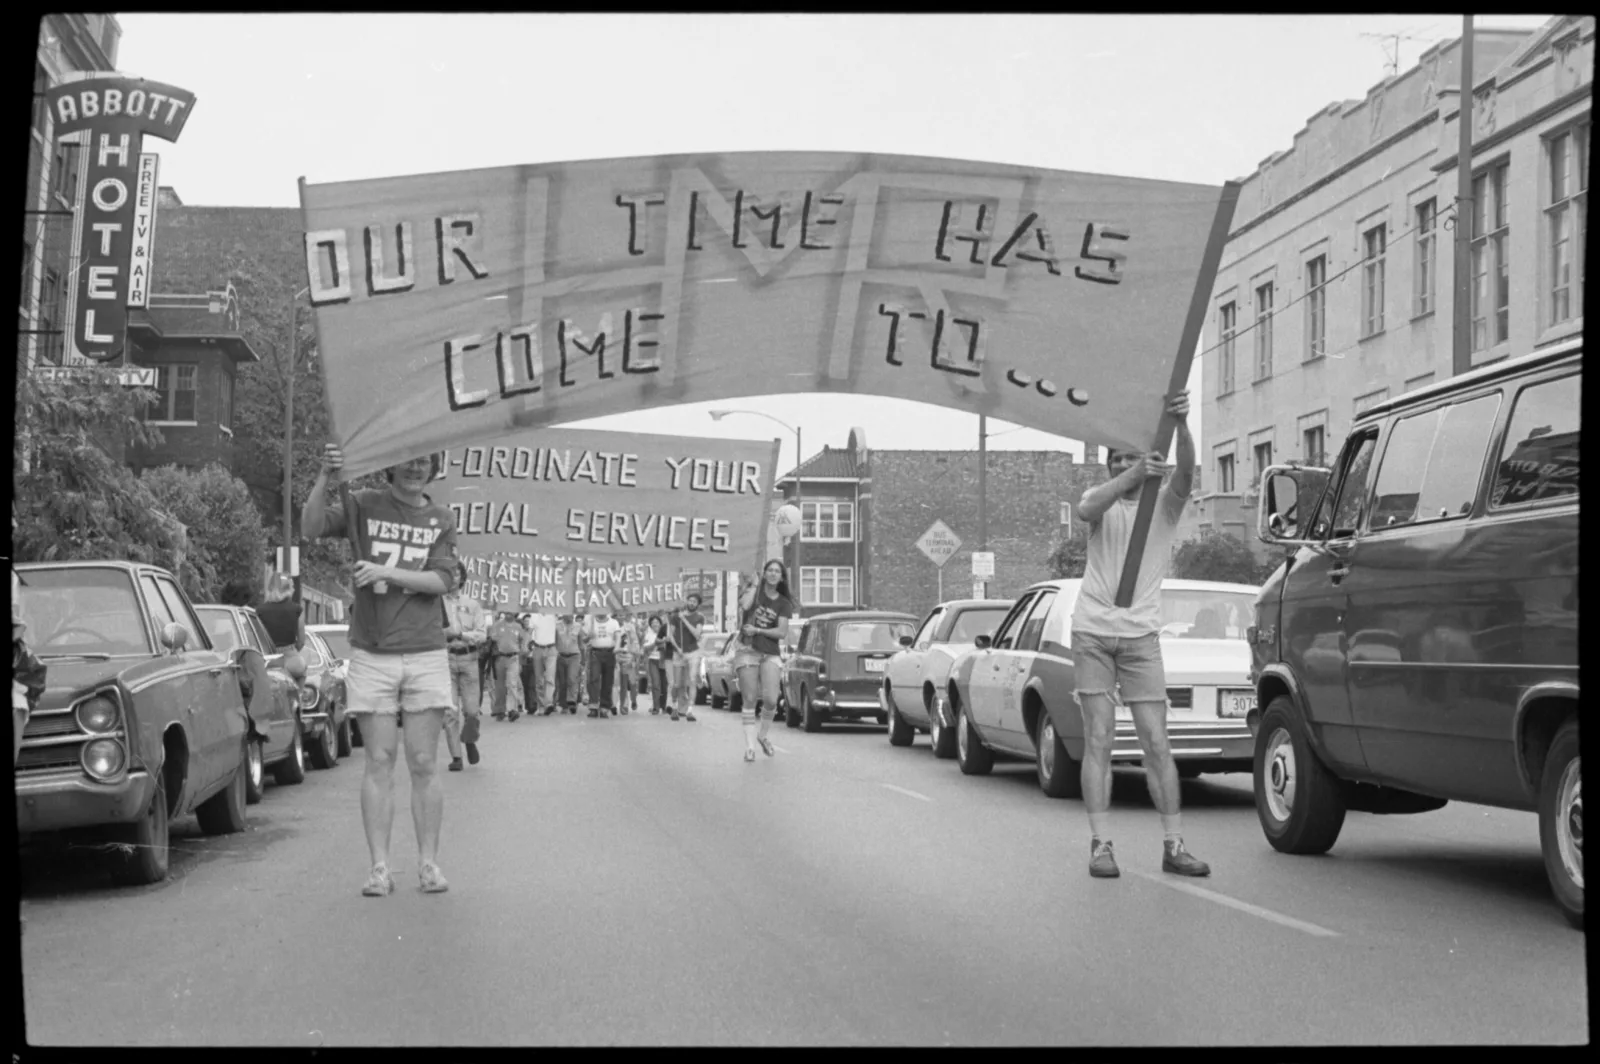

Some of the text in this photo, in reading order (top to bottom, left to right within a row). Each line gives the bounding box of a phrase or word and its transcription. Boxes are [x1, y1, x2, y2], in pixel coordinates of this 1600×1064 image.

[57, 88, 186, 124] ABBOTT
[84, 133, 130, 343] HOTEL
[131, 158, 153, 302] FREE TV & AIR
[303, 188, 1130, 307] OUR TIME HAS
[444, 308, 665, 412] COME
[436, 446, 761, 496] -ORDINATE YOUR
[448, 502, 538, 536] OCIAL
[566, 508, 731, 553] SERVICES
[460, 579, 509, 604] OGERS
[519, 586, 567, 608] PARK
[575, 588, 611, 609] GAY
[622, 581, 684, 607] CENTER
[575, 562, 656, 586] MIDWEST
